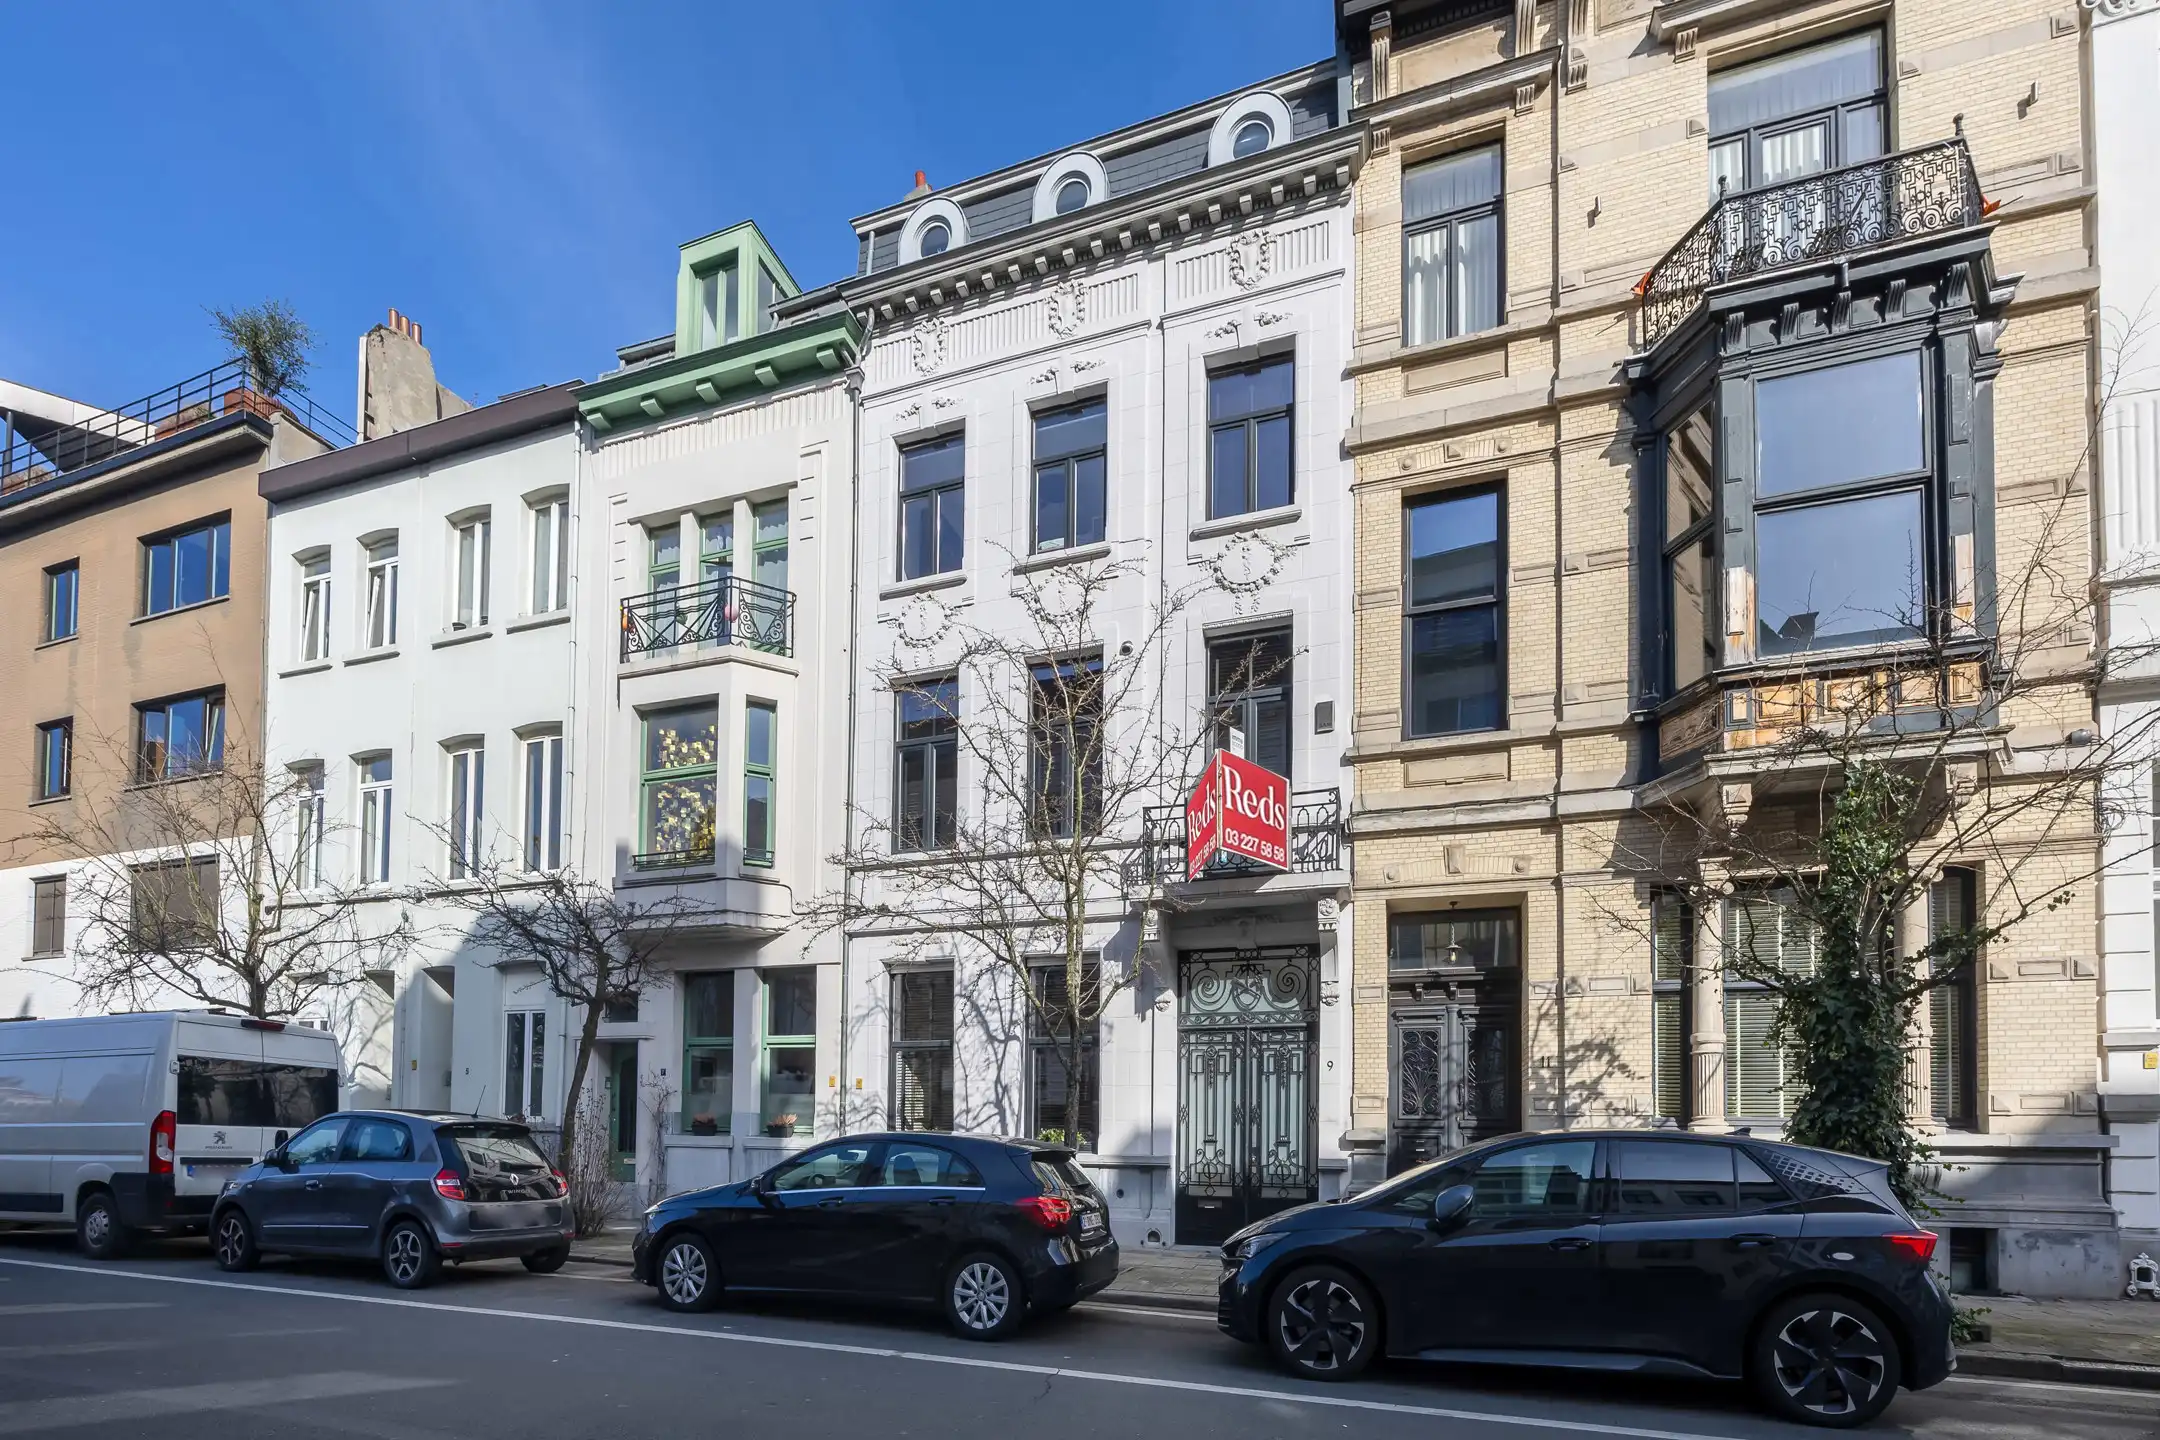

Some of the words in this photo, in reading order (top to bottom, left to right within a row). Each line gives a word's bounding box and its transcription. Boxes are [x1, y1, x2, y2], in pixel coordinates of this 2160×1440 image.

[1188, 781, 1216, 849] Reds
[1222, 764, 1285, 831] Reds
[1225, 828, 1239, 846] 03
[1240, 833, 1259, 853] 227
[1260, 840, 1273, 858] 58
[1273, 845, 1285, 862] 58
[1326, 1060, 1334, 1072] 9
